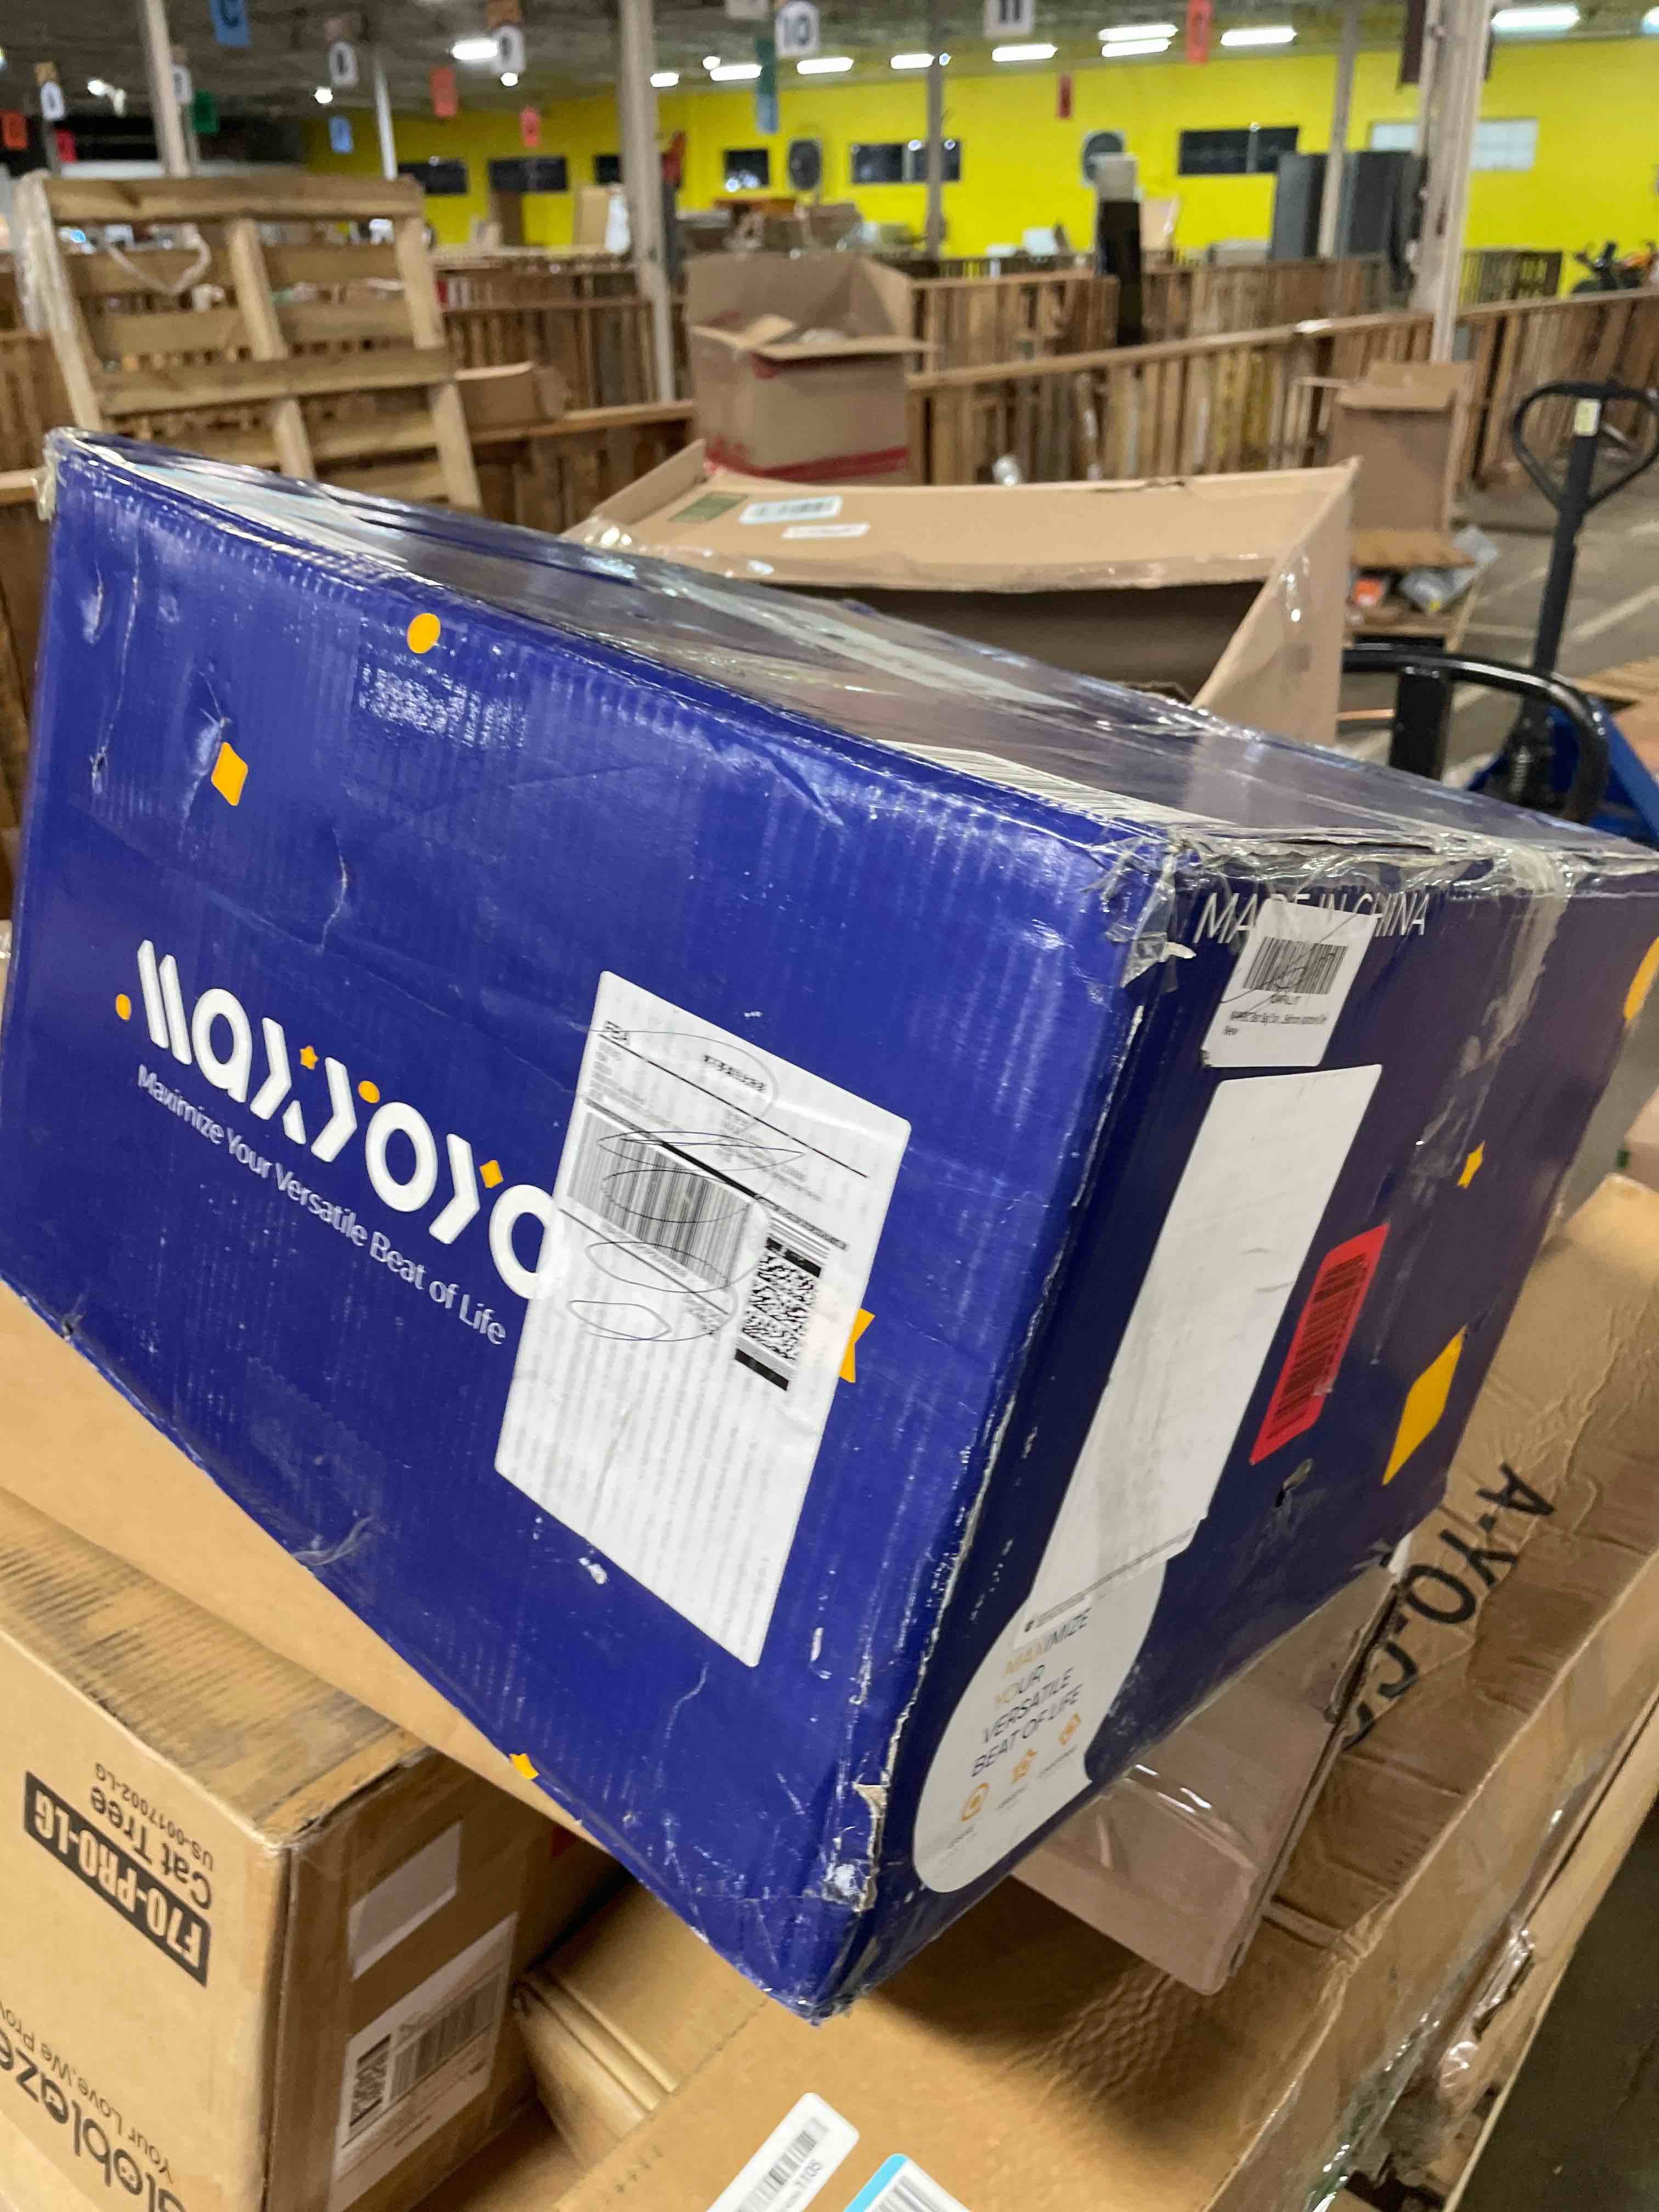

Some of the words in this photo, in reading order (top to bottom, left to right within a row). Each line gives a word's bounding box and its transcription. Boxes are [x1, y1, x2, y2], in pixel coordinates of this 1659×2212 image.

[137, 1063, 225, 1144] Maximize
[226, 1127, 273, 1179] Your
[275, 1161, 368, 1247] Versatile
[369, 1231, 426, 1290] Beat
[428, 1280, 460, 1308] of
[459, 1294, 507, 1345] Life
[983, 1667, 1075, 1743] VERSATILE
[970, 1729, 1022, 1778] BEAT
[90, 1785, 153, 1865] Tree
[94, 1762, 215, 1872] US-0017002-LG
[34, 1788, 204, 1970] F70-PRO-LG
[161, 1842, 212, 1910] Cat
[127, 2126, 173, 2186] Your
